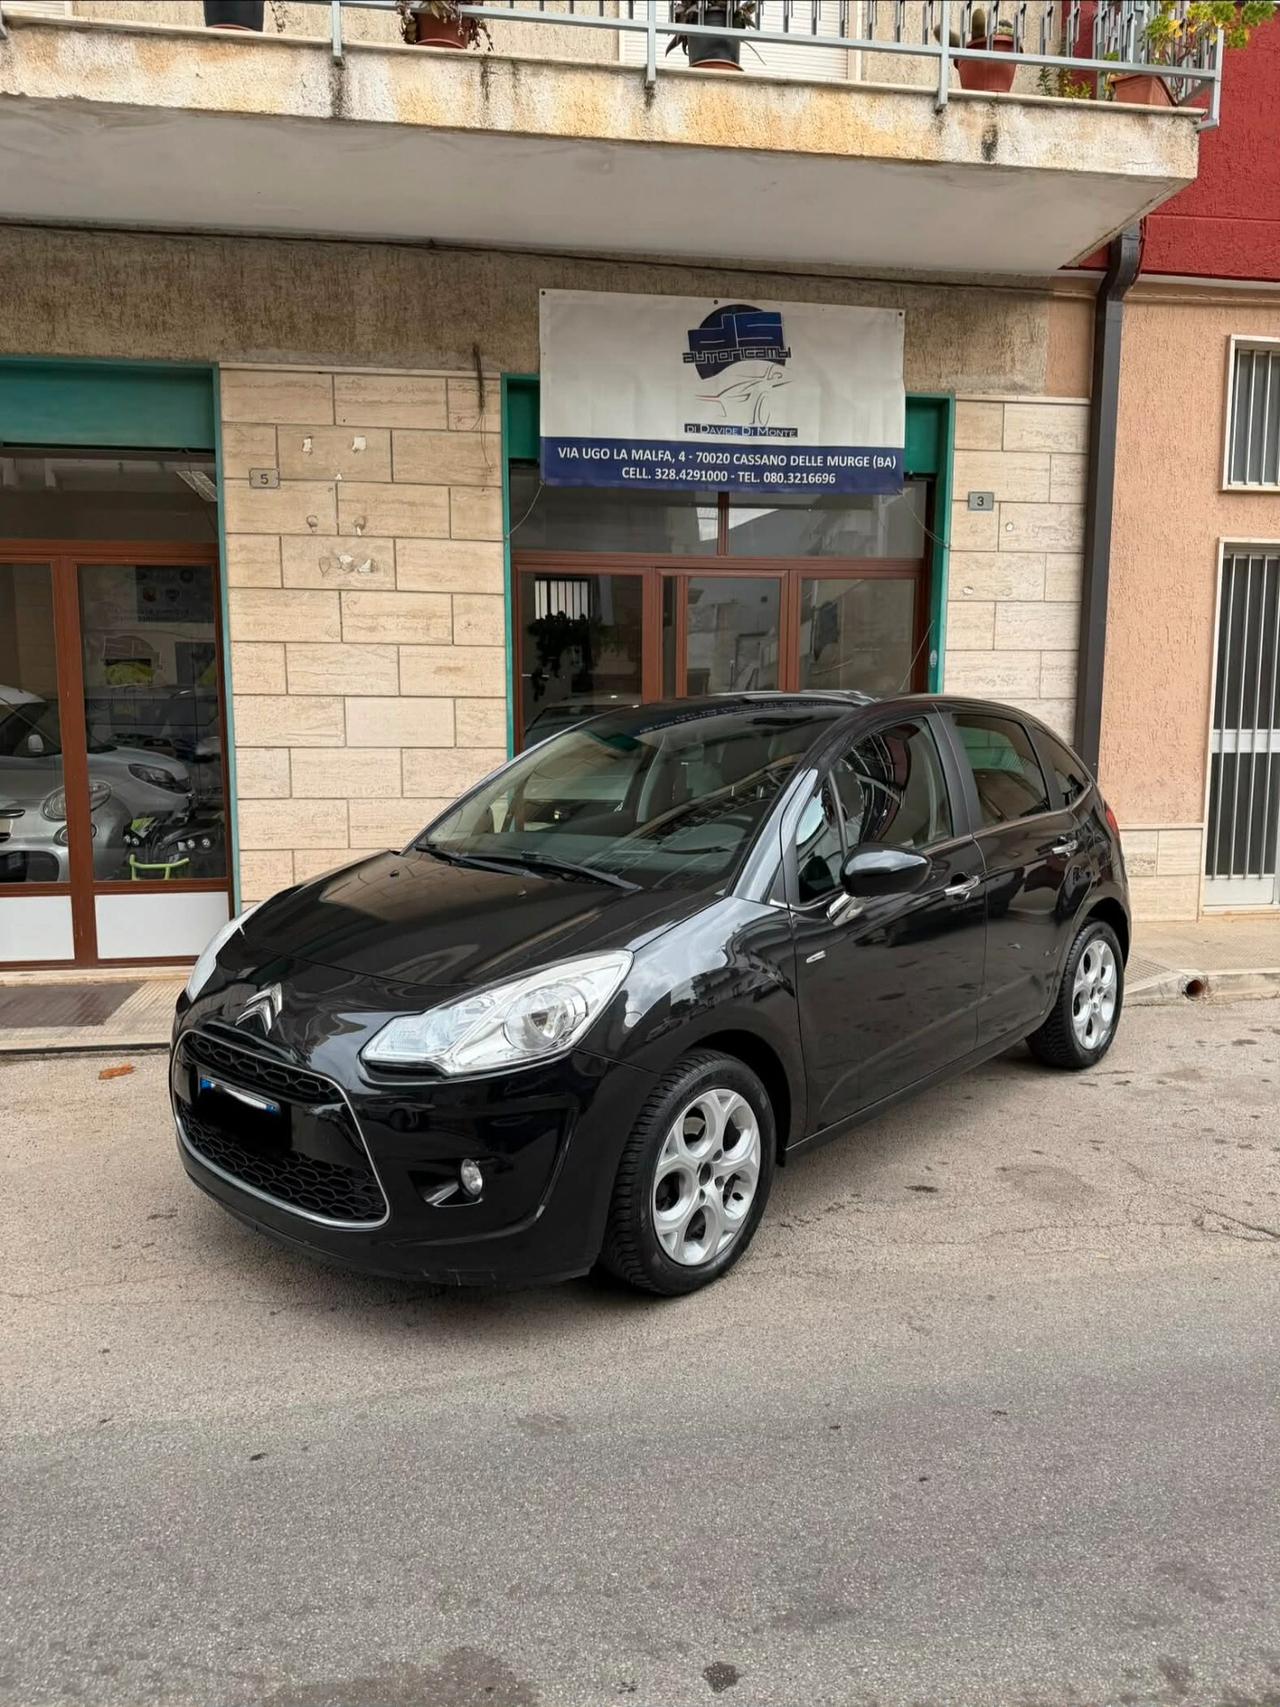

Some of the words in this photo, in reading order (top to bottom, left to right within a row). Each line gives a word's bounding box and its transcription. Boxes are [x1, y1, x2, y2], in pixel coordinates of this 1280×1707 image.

[701, 424, 738, 435] DAVIDE
[757, 426, 797, 438] MONTE
[558, 447, 579, 459] VIA
[582, 448, 610, 460] UGO
[613, 449, 628, 460] LA
[631, 449, 675, 463] MALFA,
[678, 451, 686, 462] 4
[696, 452, 730, 464] 70020
[733, 453, 787, 466] CASSANO
[790, 455, 824, 467] DELLE
[827, 455, 870, 468] MURGE
[872, 455, 897, 469] (BA)
[260, 473, 269, 485] 5
[622, 467, 651, 479] CELL.
[655, 468, 728, 482] 328.4291000
[737, 472, 760, 483] TEL.
[763, 472, 836, 484] 080.3216696
[976, 495, 984, 507] 3
